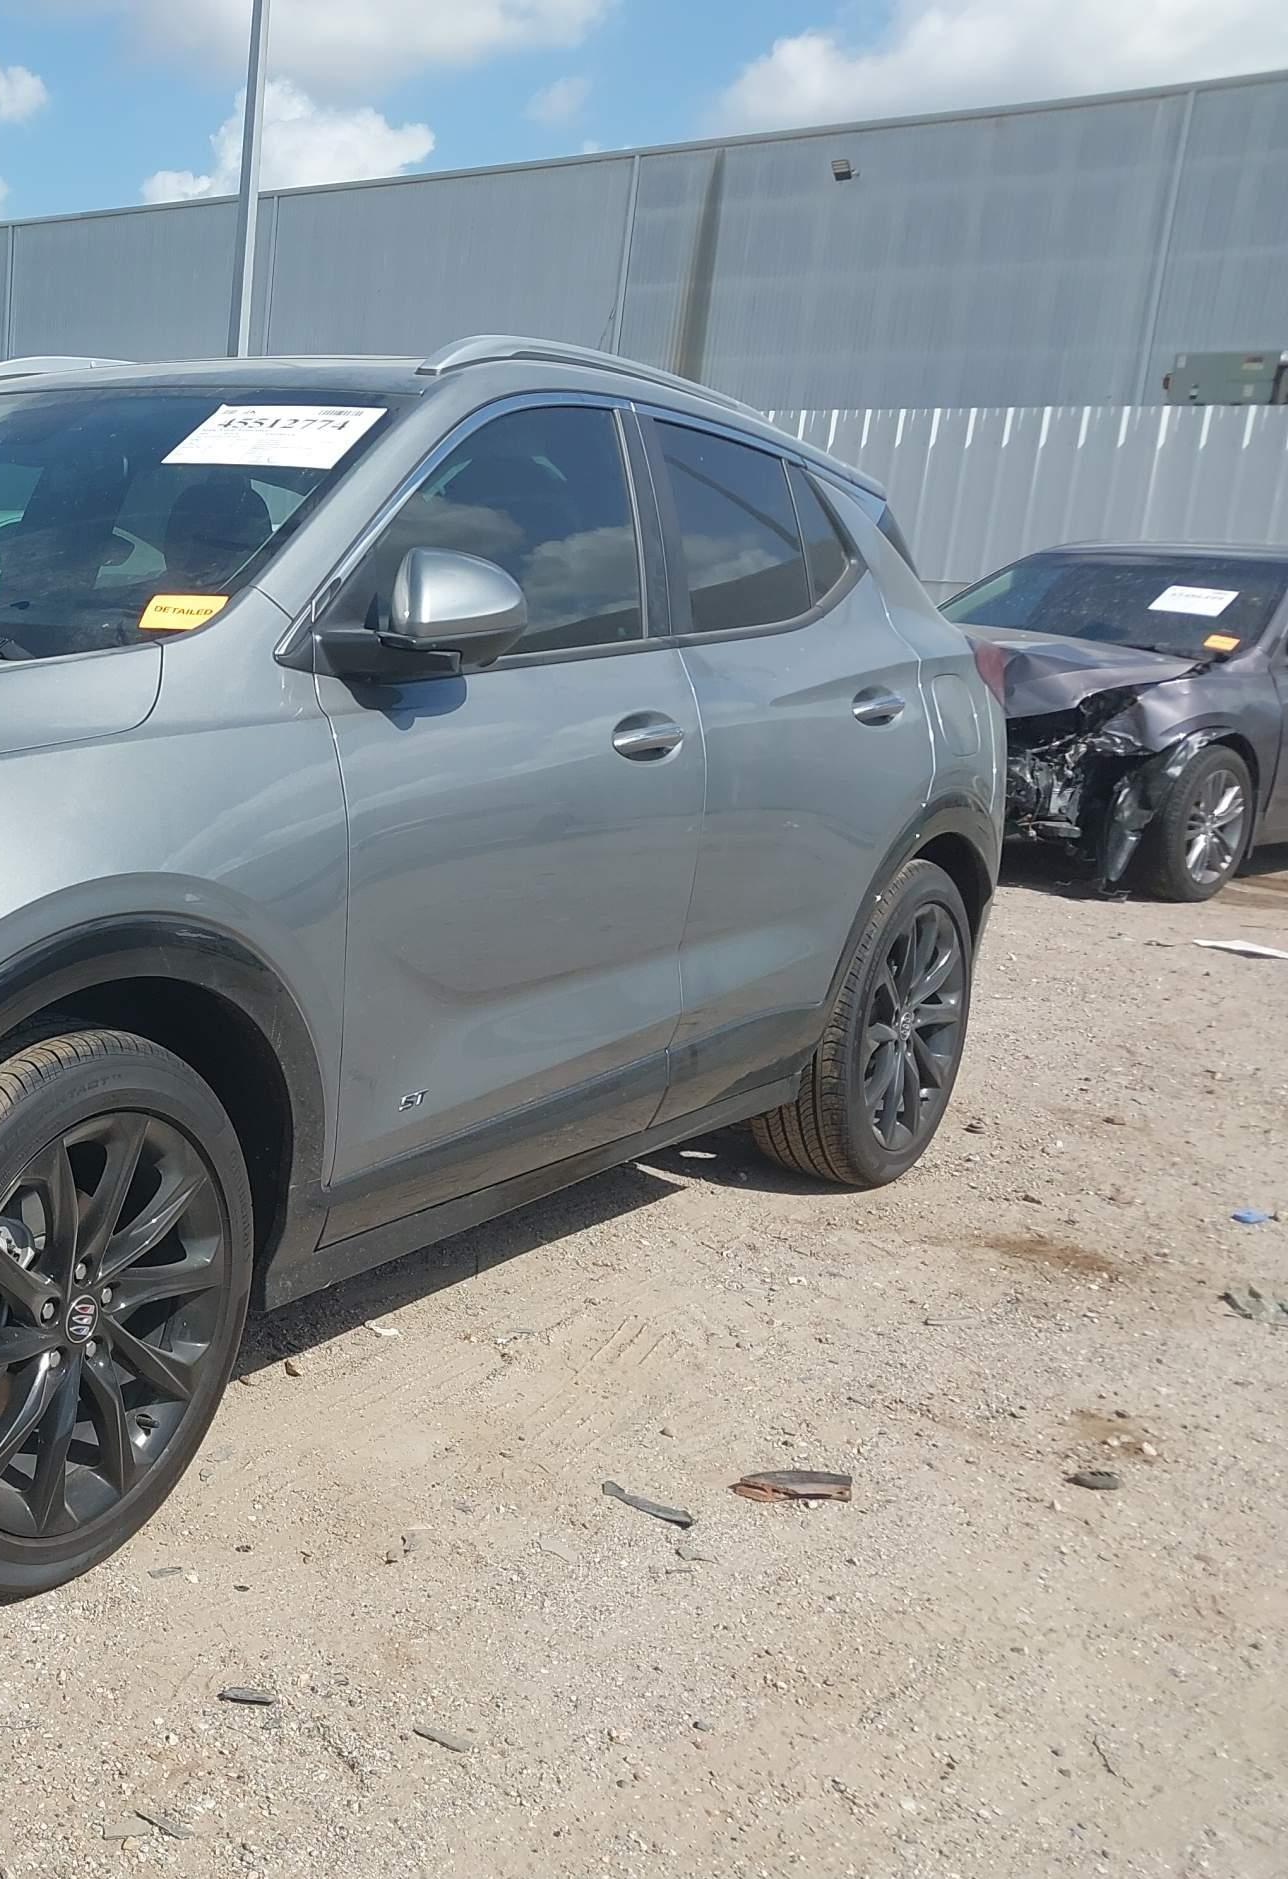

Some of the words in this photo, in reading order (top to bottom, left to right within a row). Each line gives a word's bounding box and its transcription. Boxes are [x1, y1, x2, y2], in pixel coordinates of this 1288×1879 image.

[217, 417, 350, 431] 45512774
[154, 605, 214, 616] DETAILED
[398, 1088, 430, 1112] ST
